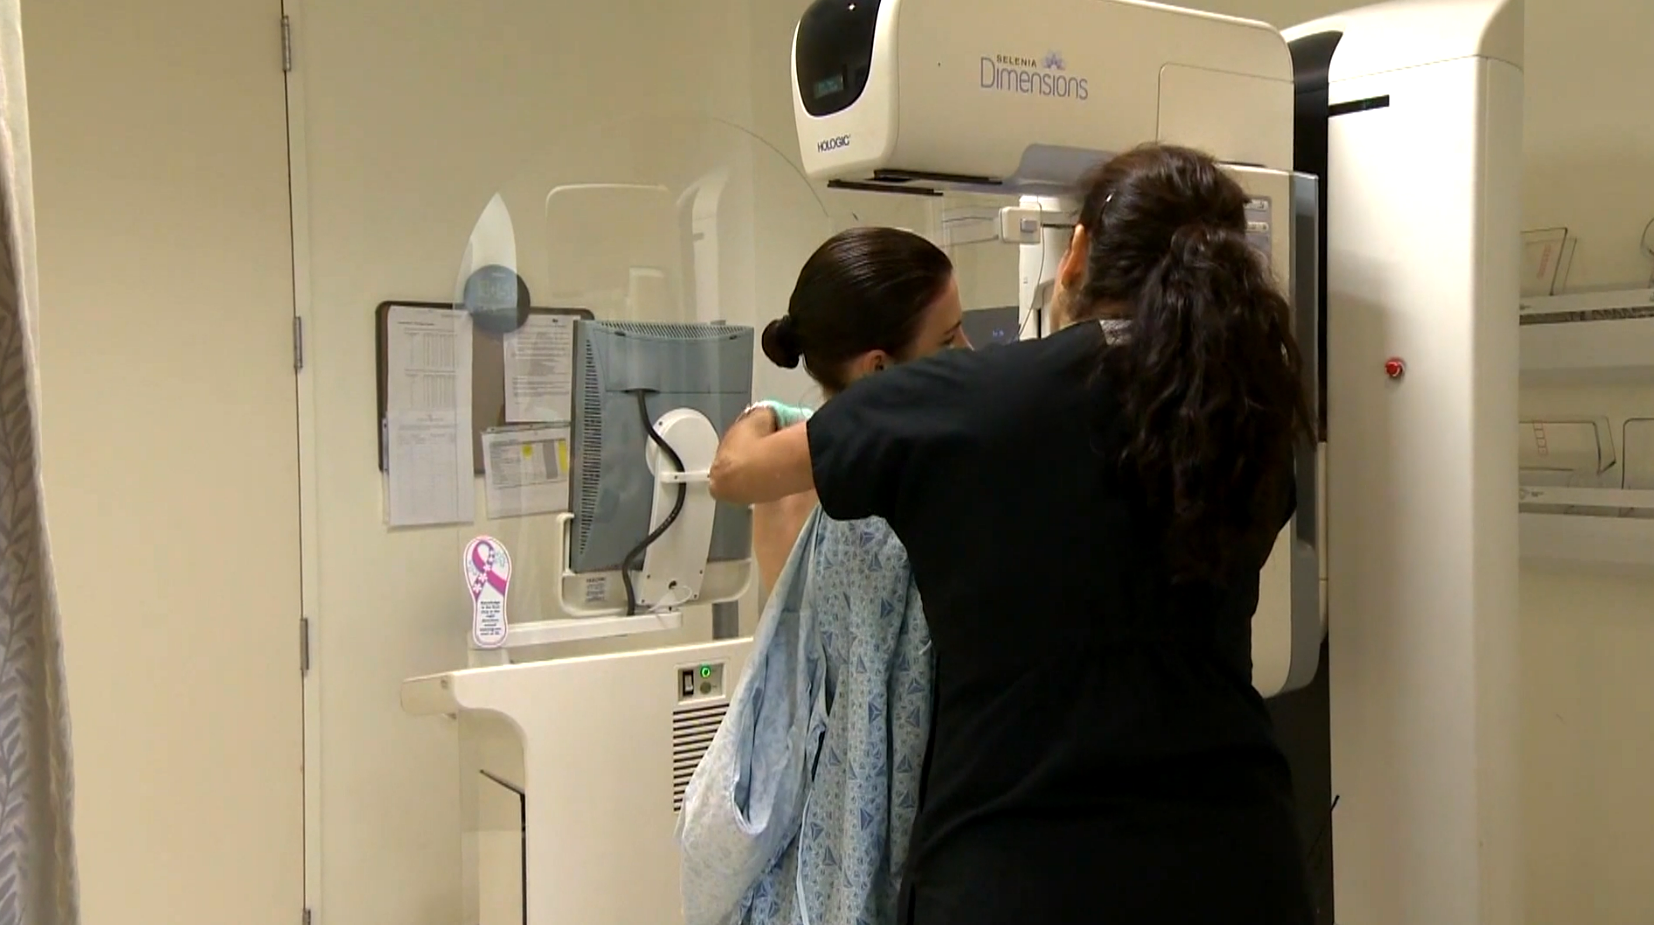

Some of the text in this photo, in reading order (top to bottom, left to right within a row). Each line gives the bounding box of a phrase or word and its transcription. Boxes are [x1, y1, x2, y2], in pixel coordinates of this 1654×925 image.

[996, 54, 1037, 68] SELENIA
[980, 56, 1089, 101] Dimensions
[817, 134, 850, 153] HOLOGIC
